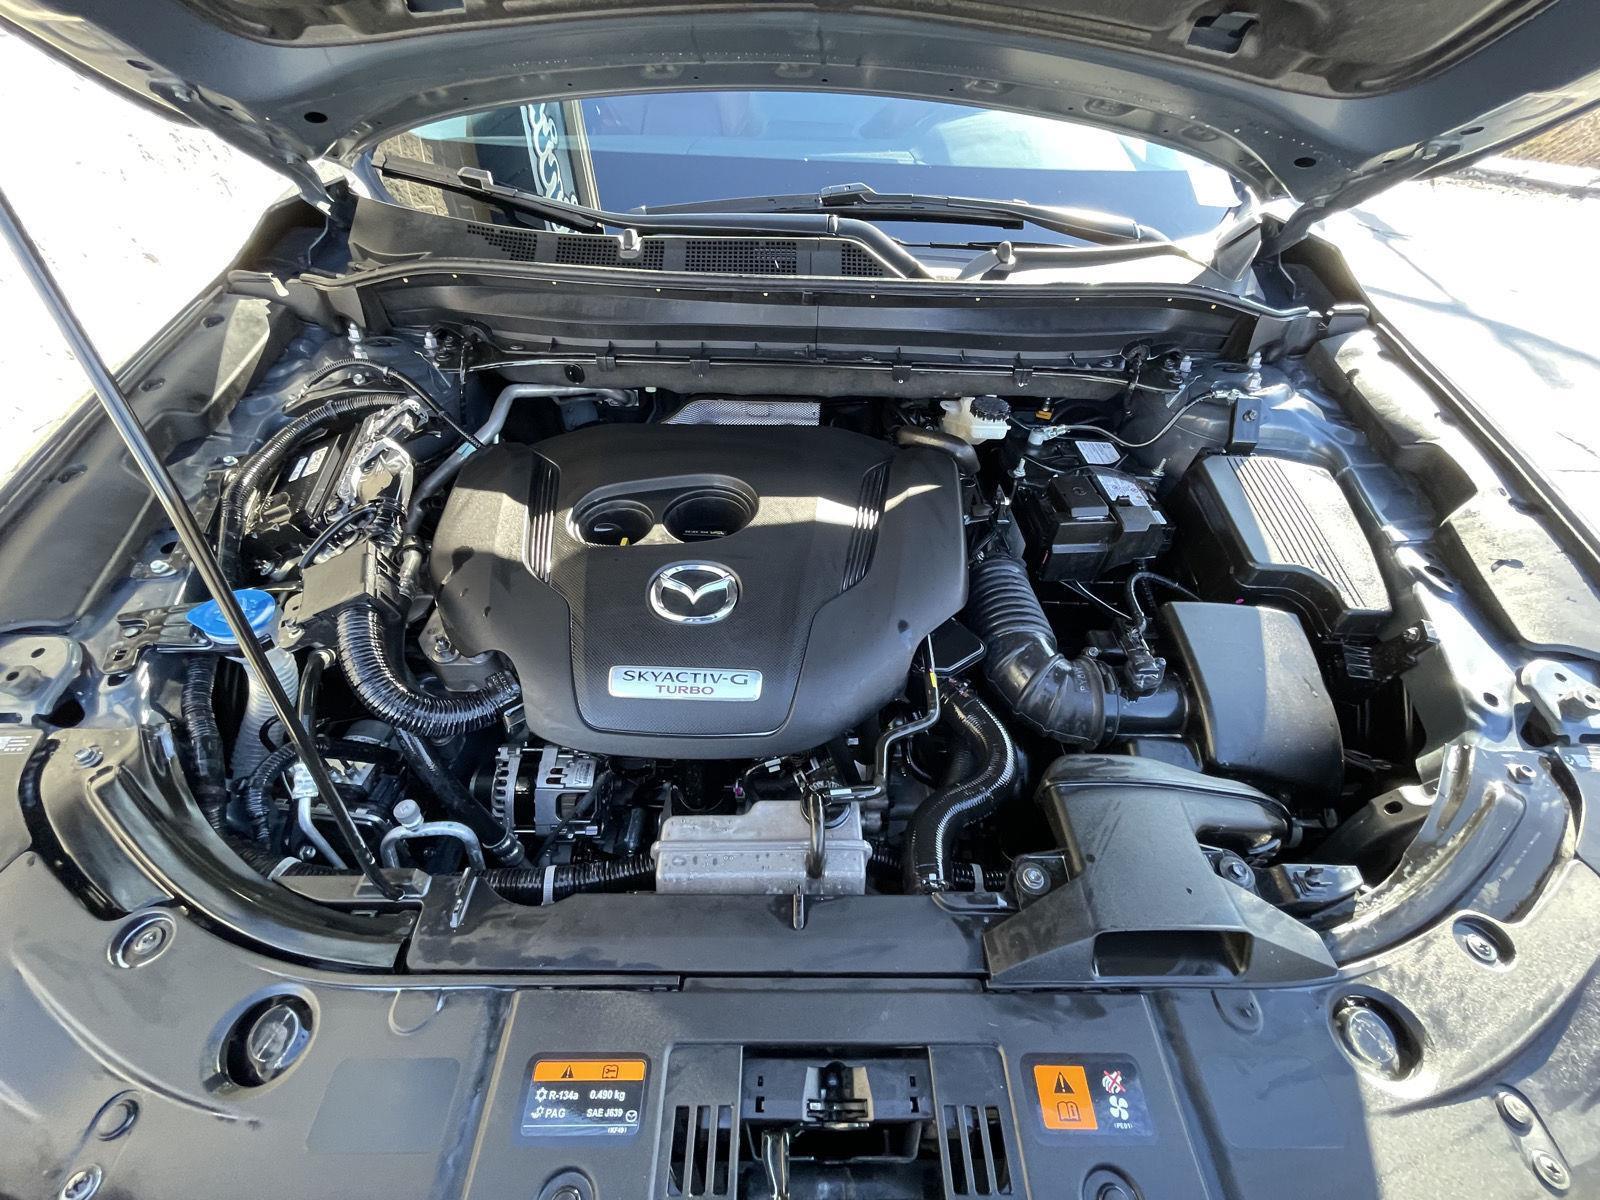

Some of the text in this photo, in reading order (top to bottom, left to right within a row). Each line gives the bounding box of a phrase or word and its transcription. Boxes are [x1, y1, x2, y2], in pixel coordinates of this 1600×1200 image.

[622, 669, 748, 685] SKYACTIV-G
[655, 684, 714, 695] TURBO
[548, 1089, 626, 1102] R-134a 0.490 kg
[545, 1108, 624, 1119] PAG SAE J639
